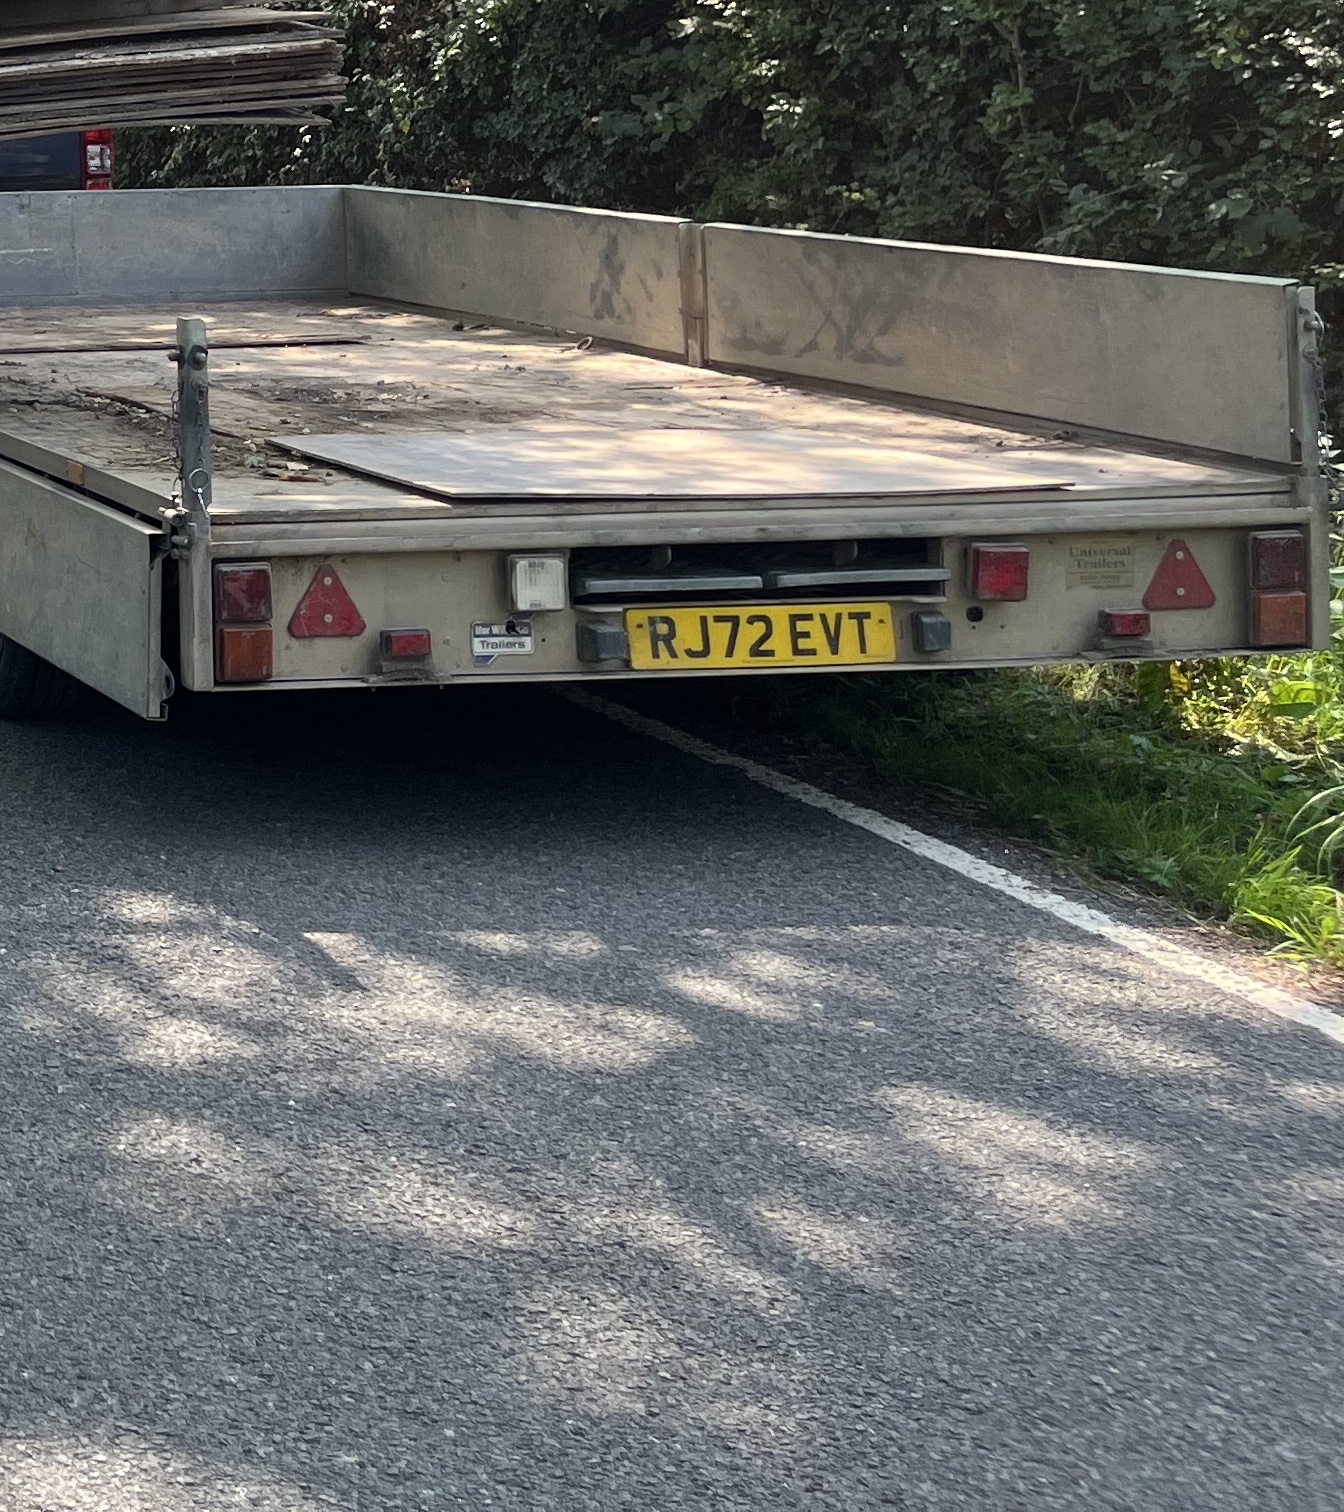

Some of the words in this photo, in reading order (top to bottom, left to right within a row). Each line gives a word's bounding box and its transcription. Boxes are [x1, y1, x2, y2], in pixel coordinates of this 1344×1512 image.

[1074, 558, 1126, 569] Trailers
[647, 614, 775, 660] RJ72
[788, 611, 872, 657] EVT
[480, 640, 526, 650] Trailers
